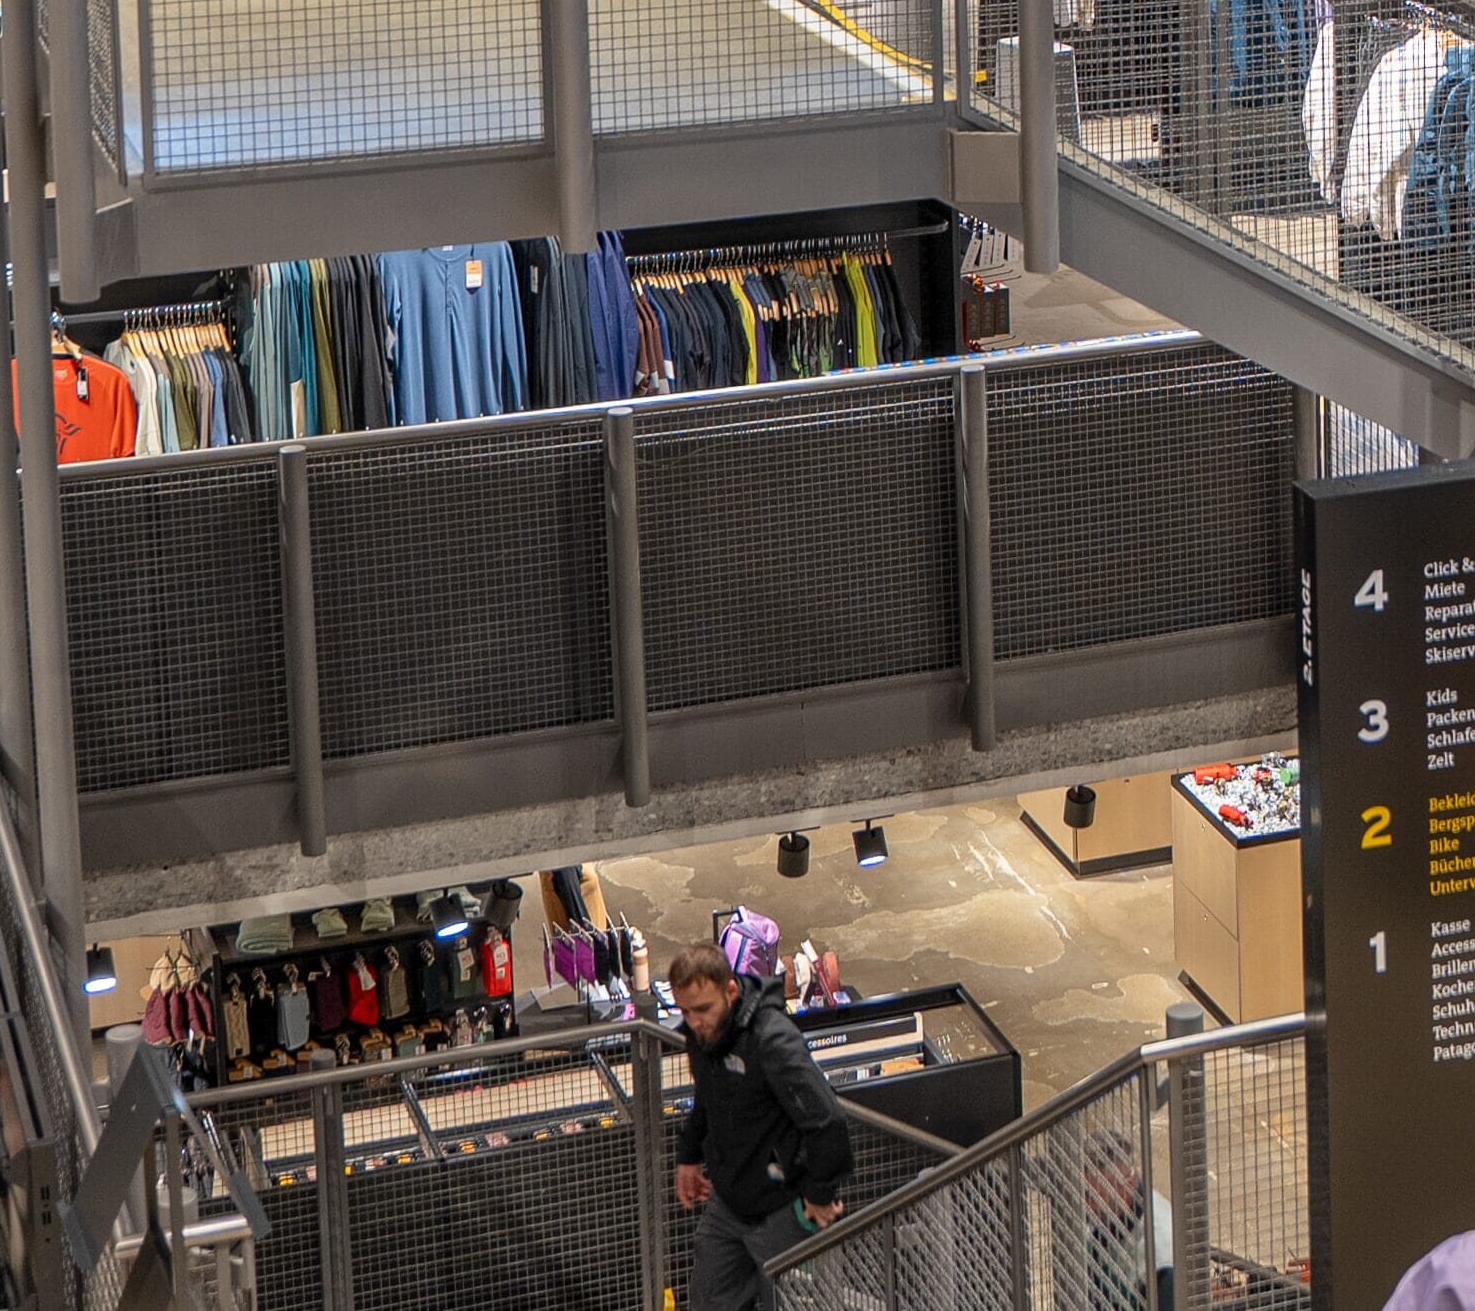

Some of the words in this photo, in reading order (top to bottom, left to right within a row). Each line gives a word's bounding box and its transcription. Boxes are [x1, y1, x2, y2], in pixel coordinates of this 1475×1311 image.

[1424, 559, 1458, 578] Click
[1462, 557, 1474, 572] &
[1354, 569, 1389, 612] 4
[1425, 581, 1465, 599] Miete
[1301, 568, 1312, 657] ETAGE
[1427, 688, 1457, 706] Kids
[1358, 699, 1390, 744] 3
[1427, 708, 1475, 727] Packen
[1428, 752, 1454, 769] Zelt
[1361, 805, 1393, 850] 2
[1430, 837, 1459, 854] Bike
[1431, 919, 1470, 937] Kasse
[1369, 930, 1387, 974] 1
[807, 1033, 847, 1050] cessoires
